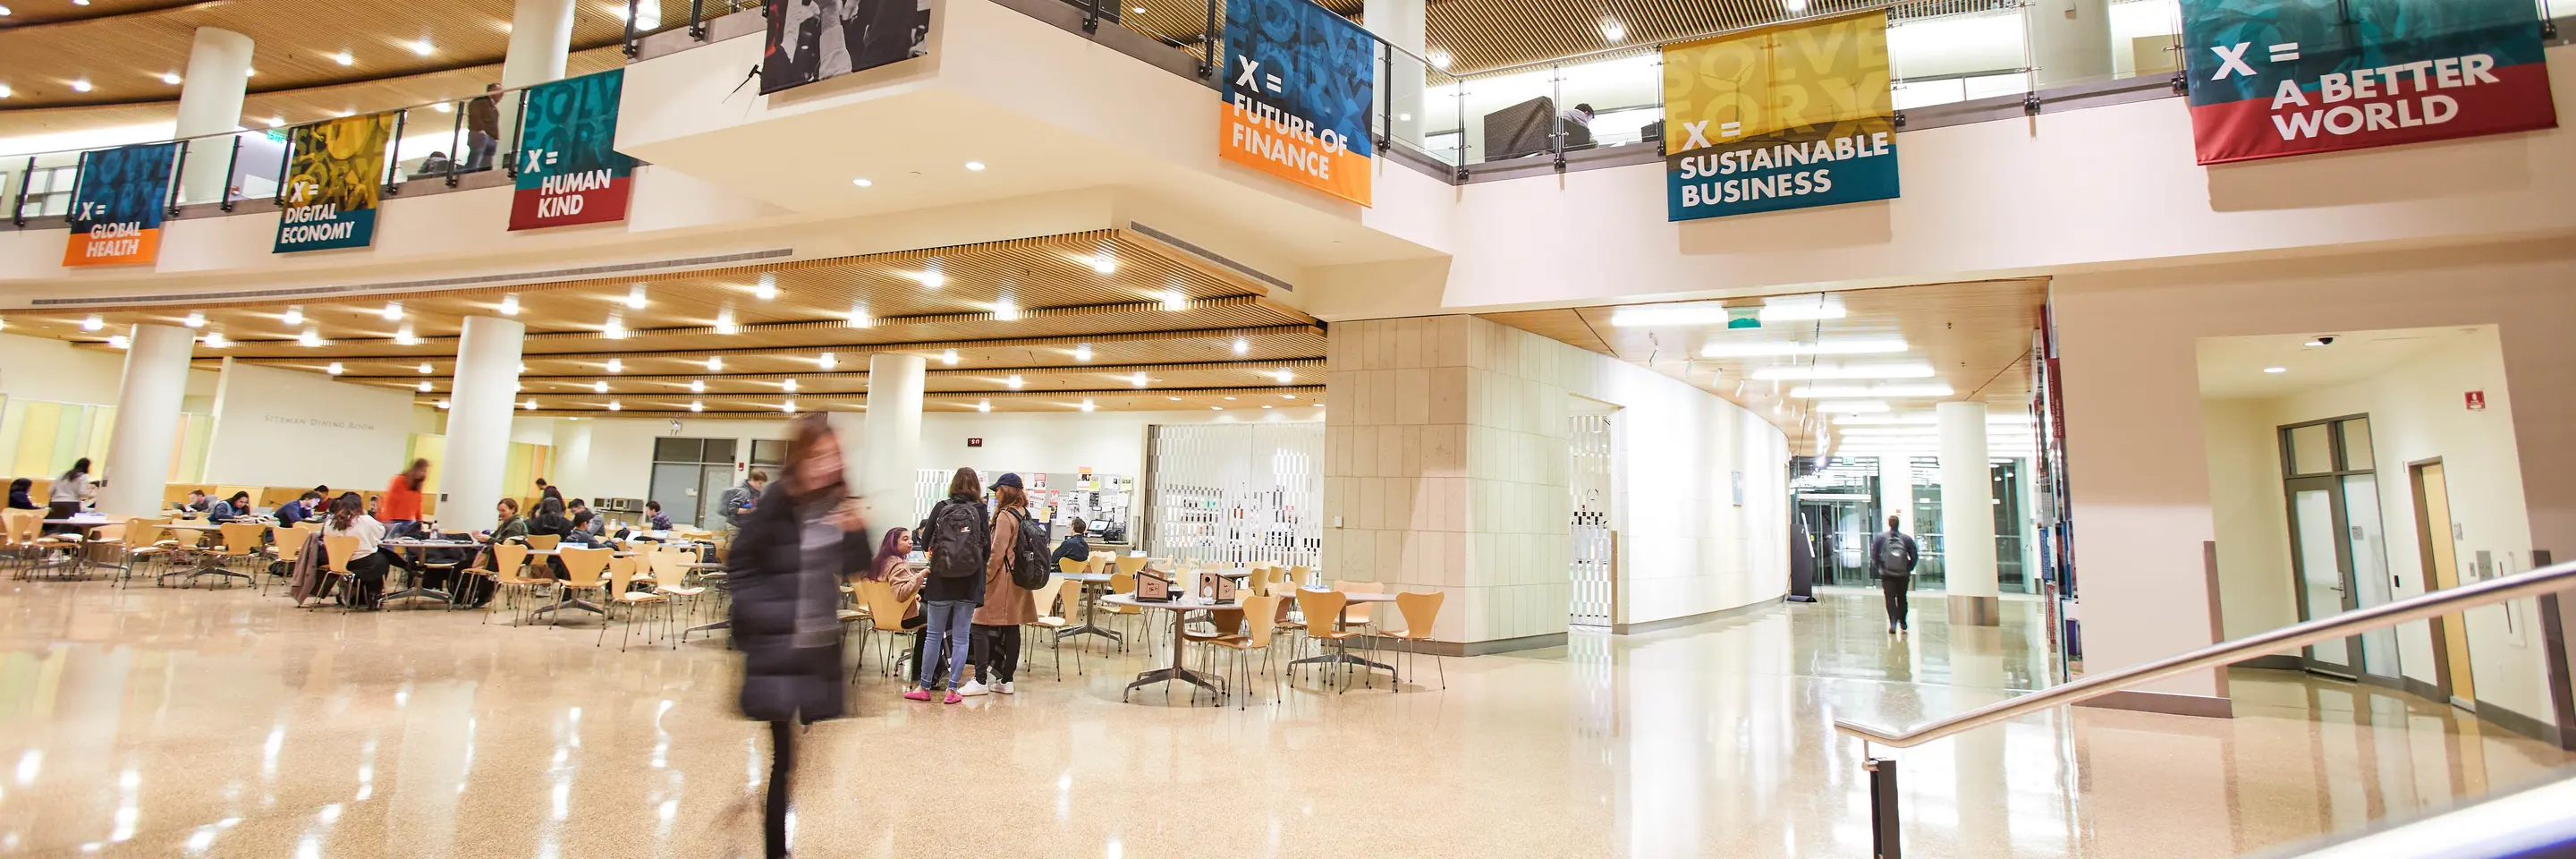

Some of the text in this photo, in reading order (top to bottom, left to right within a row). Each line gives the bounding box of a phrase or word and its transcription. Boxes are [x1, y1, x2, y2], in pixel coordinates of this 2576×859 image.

[1235, 55, 1259, 93] X
[2210, 41, 2258, 81] X
[2270, 54, 2500, 110] A BETTER
[1233, 91, 1348, 157] FUTURE OF
[2270, 95, 2459, 141] WORLD
[1682, 120, 1712, 151] X
[524, 149, 543, 174] X
[1233, 122, 1329, 180] FINANCE
[1680, 132, 1889, 179] SUSTAINABLE
[290, 181, 305, 203] X
[540, 168, 612, 196] HUMAN
[1682, 169, 1832, 208] BUSINESS
[79, 201, 95, 221] X
[284, 203, 337, 224] DIGITAL
[538, 194, 584, 218] KIND
[90, 221, 141, 239] GLOBAL
[281, 221, 356, 243] ECONOMY
[86, 239, 140, 258] HEALTH
[264, 414, 374, 430] SITEMAN DINING ROOM
